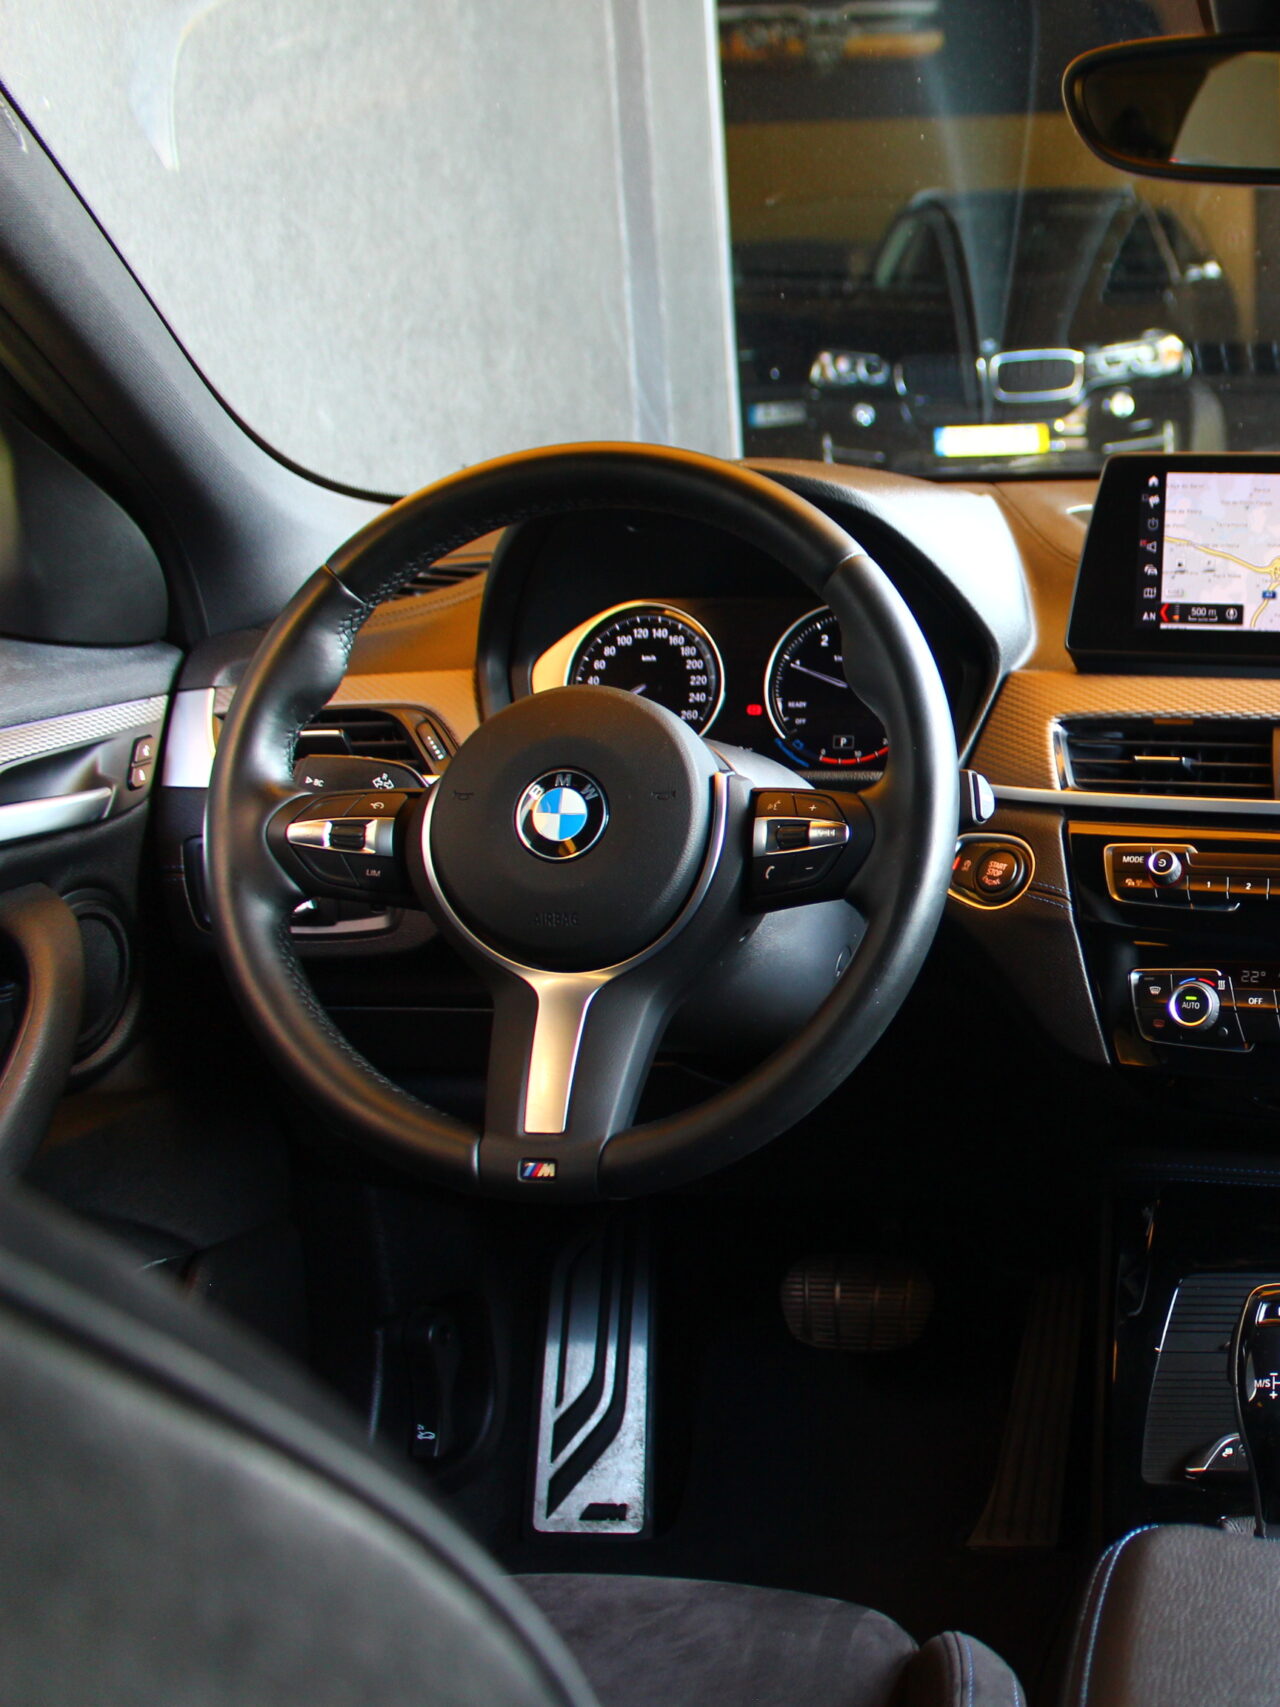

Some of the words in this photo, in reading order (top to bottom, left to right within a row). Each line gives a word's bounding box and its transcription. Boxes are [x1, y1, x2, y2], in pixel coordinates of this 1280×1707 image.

[1191, 607, 1207, 616] 500
[1208, 608, 1217, 616] m
[633, 628, 649, 638] 120
[652, 628, 668, 638] 140
[616, 635, 633, 646] 100
[669, 635, 685, 646] 160
[820, 634, 829, 647] 2
[603, 646, 616, 656] 80
[680, 646, 697, 656] 180
[593, 660, 606, 670] 60
[686, 660, 704, 670] 200
[587, 676, 600, 685] 40
[689, 676, 707, 686] 220
[688, 693, 706, 703] 240
[680, 710, 698, 720] 260
[840, 737, 847, 747] P
[529, 773, 599, 800] BMW
[1122, 855, 1145, 864] MODE
[989, 860, 1008, 871] START
[365, 869, 381, 877] LIM
[986, 867, 1003, 877] STOP
[1206, 881, 1211, 889] 1
[1245, 882, 1252, 890] 2
[534, 912, 578, 928] AIRBAG
[1181, 1001, 1201, 1010] AUTO
[1248, 997, 1263, 1005] OFF
[1254, 1378, 1271, 1388] M/S
